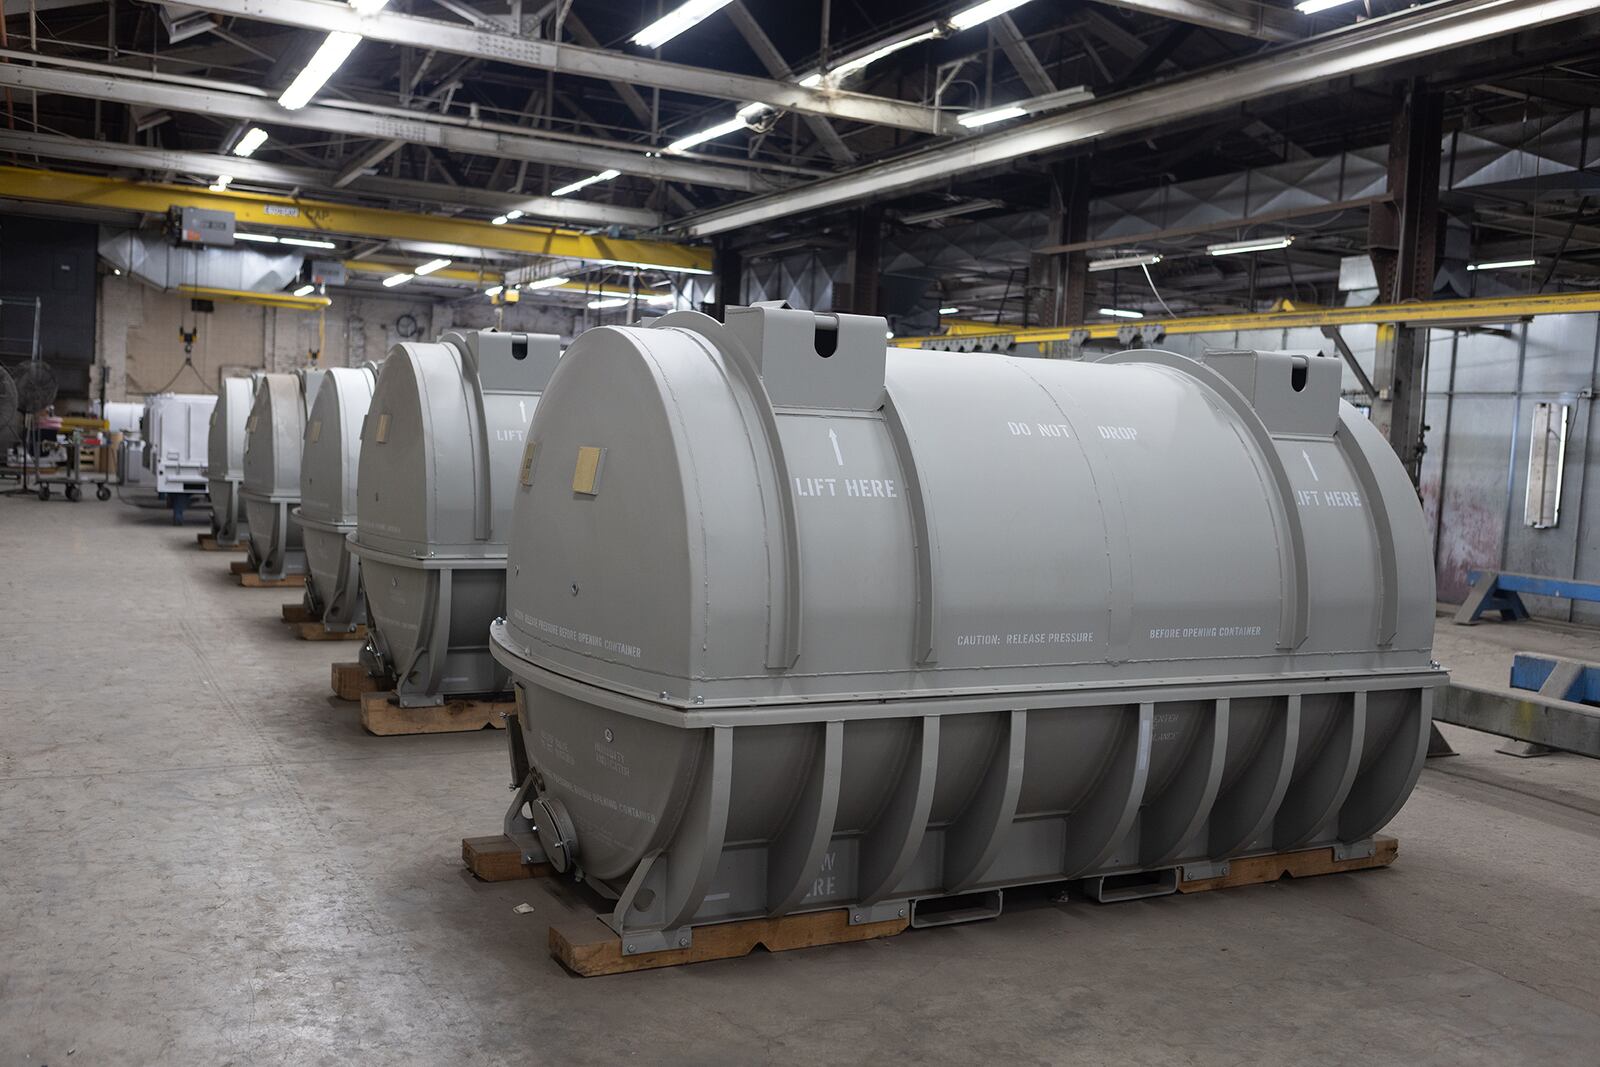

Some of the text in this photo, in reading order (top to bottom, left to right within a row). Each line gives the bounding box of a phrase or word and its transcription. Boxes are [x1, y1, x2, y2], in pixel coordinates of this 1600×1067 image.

[496, 430, 523, 442] LIFT
[1007, 421, 1137, 441] DO NOT DROP
[795, 477, 897, 498] LIFT HERE
[1297, 490, 1361, 507] IFT HERE
[559, 627, 577, 641] BEFORE
[578, 632, 602, 648] OPENING
[604, 639, 641, 658] CONTAINER
[957, 625, 1261, 646] CAUTION: RELEASE PRESSURE BEFORE OPENING CONTAINER
